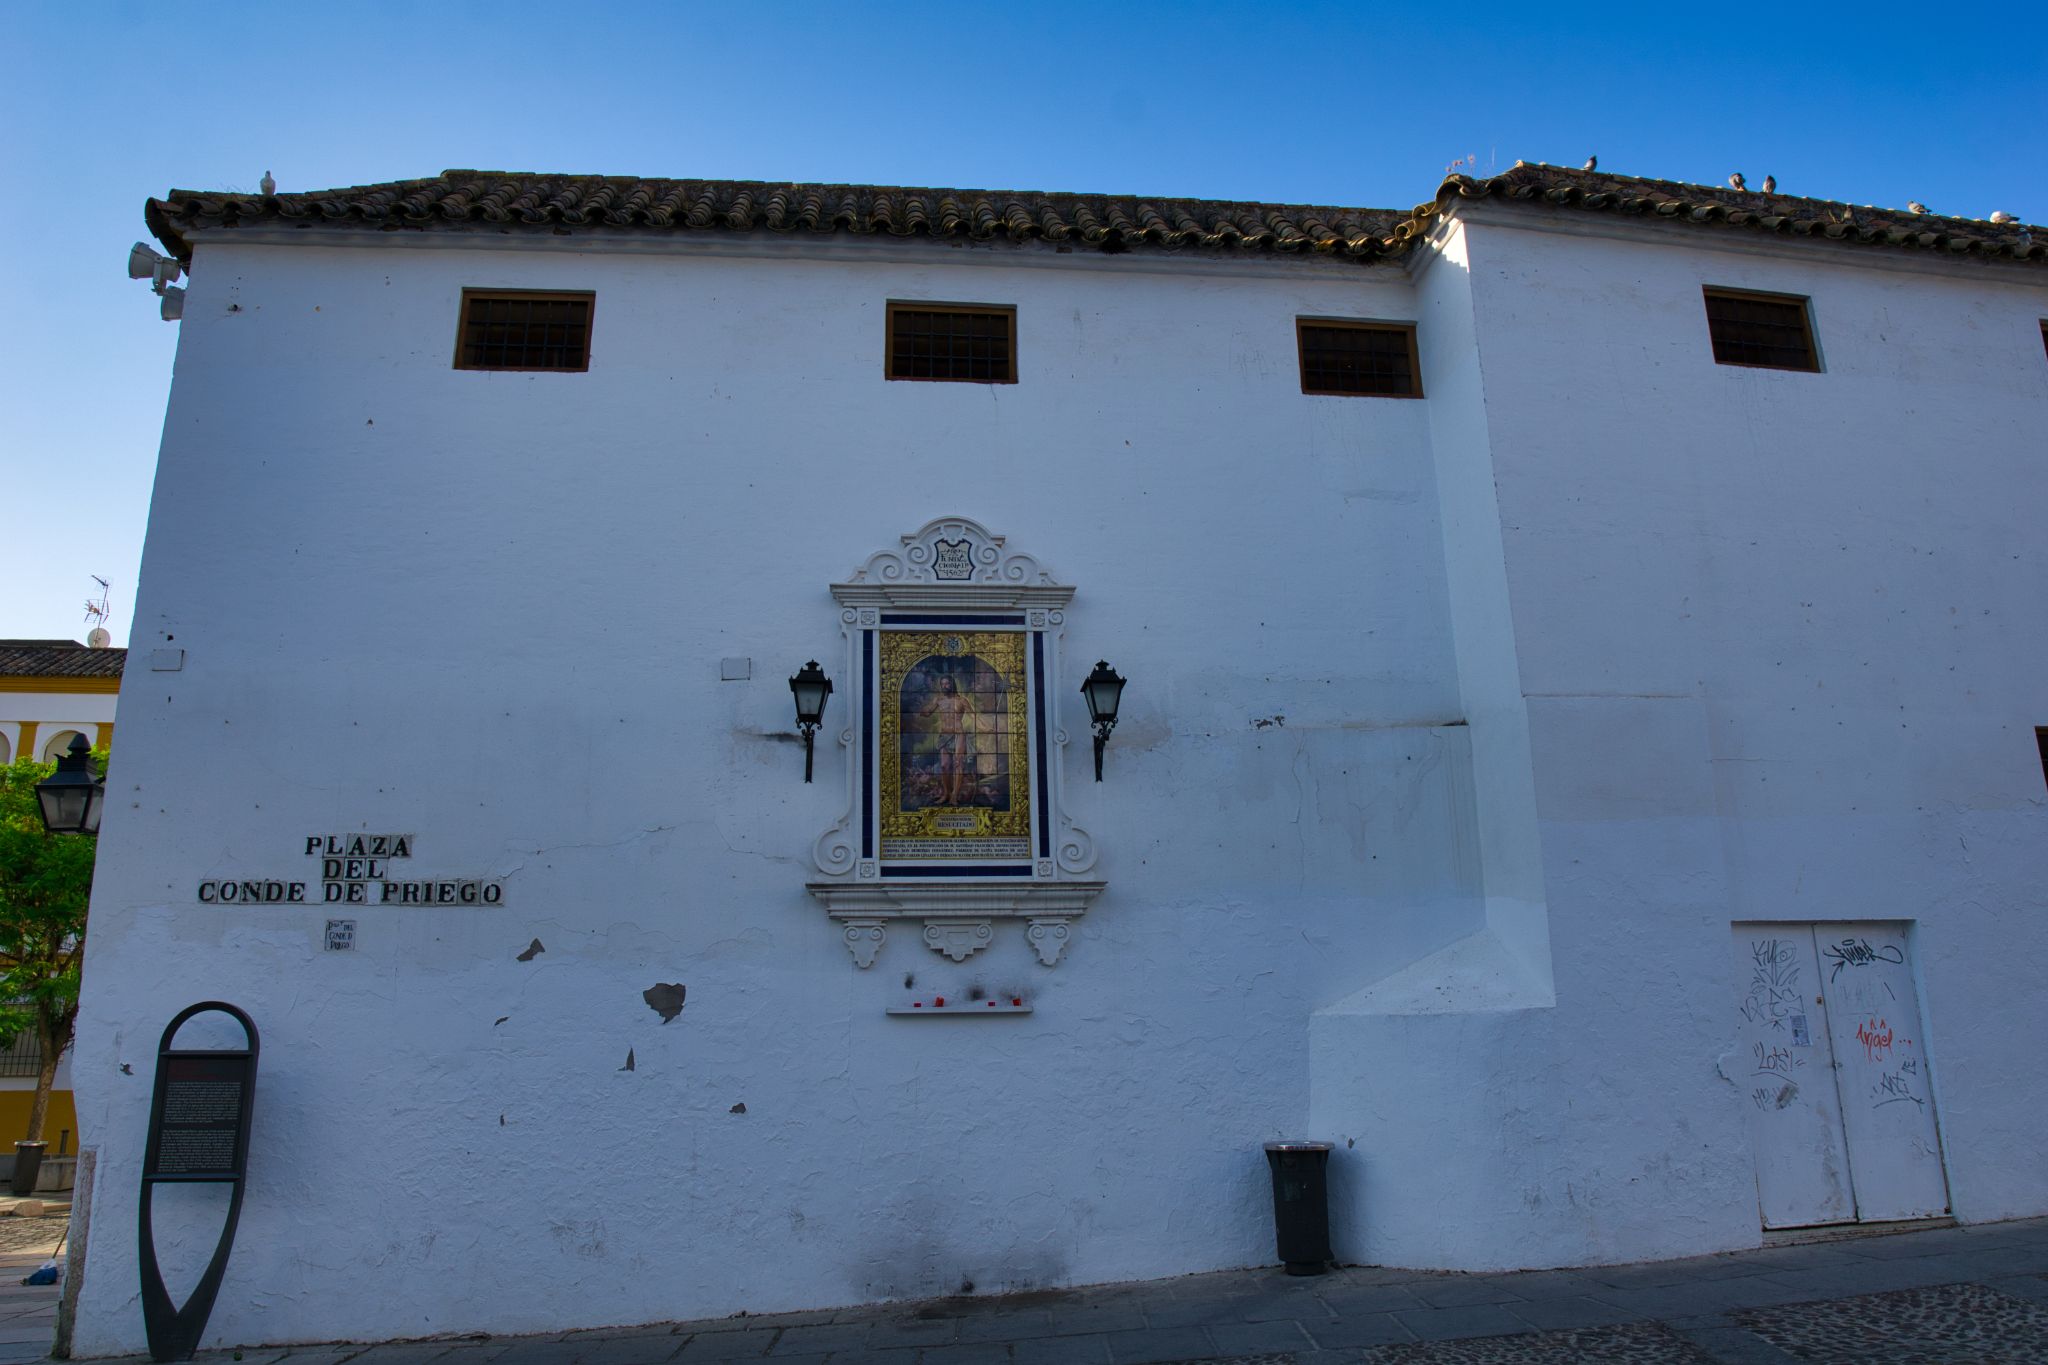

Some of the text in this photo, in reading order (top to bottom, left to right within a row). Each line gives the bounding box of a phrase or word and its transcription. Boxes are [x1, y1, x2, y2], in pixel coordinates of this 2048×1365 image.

[305, 836, 410, 857] PLAZA
[324, 859, 384, 878] DEL
[198, 882, 502, 902] CONDE DE PRIEGO
